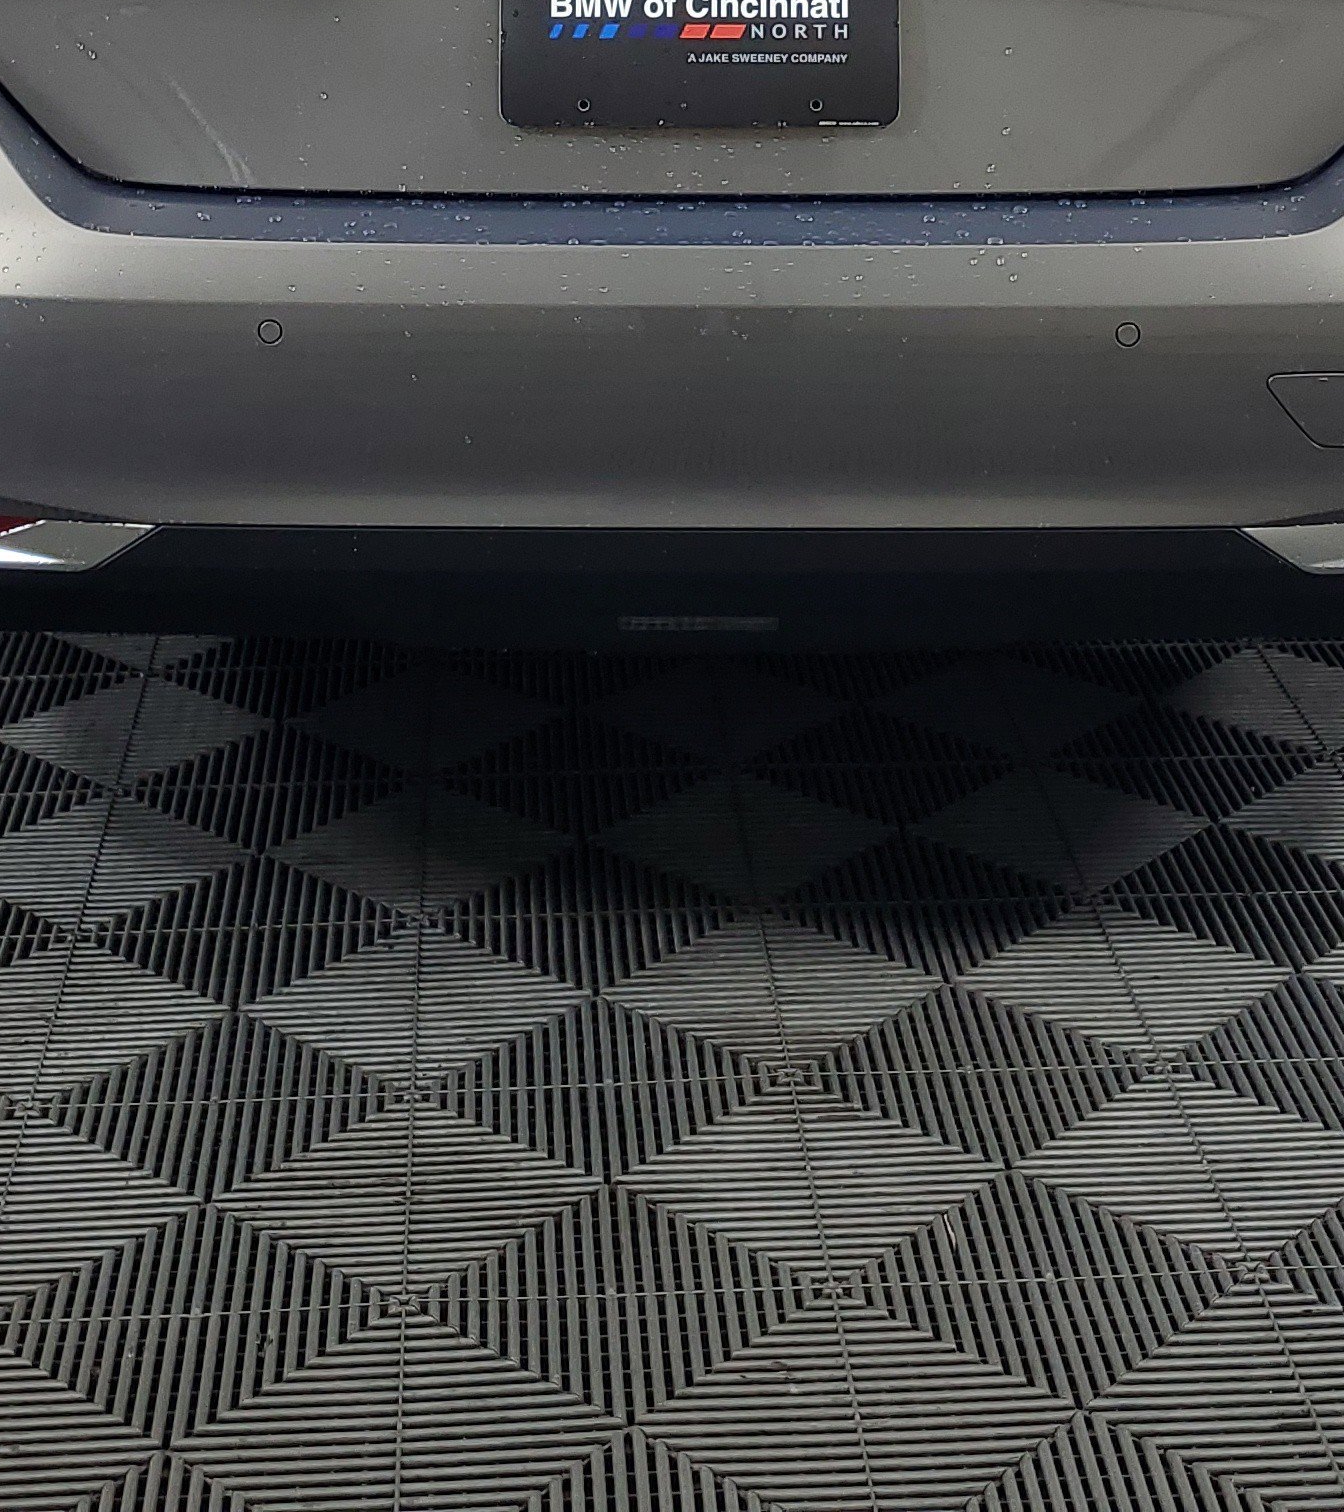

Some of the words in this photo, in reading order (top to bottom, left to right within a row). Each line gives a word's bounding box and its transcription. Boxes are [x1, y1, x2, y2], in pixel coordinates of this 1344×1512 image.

[750, 23, 849, 39] NORTH
[687, 53, 697, 63] A
[698, 53, 729, 63] JAKE
[731, 53, 789, 63] SWEENEY
[790, 53, 848, 63] COMPANY
